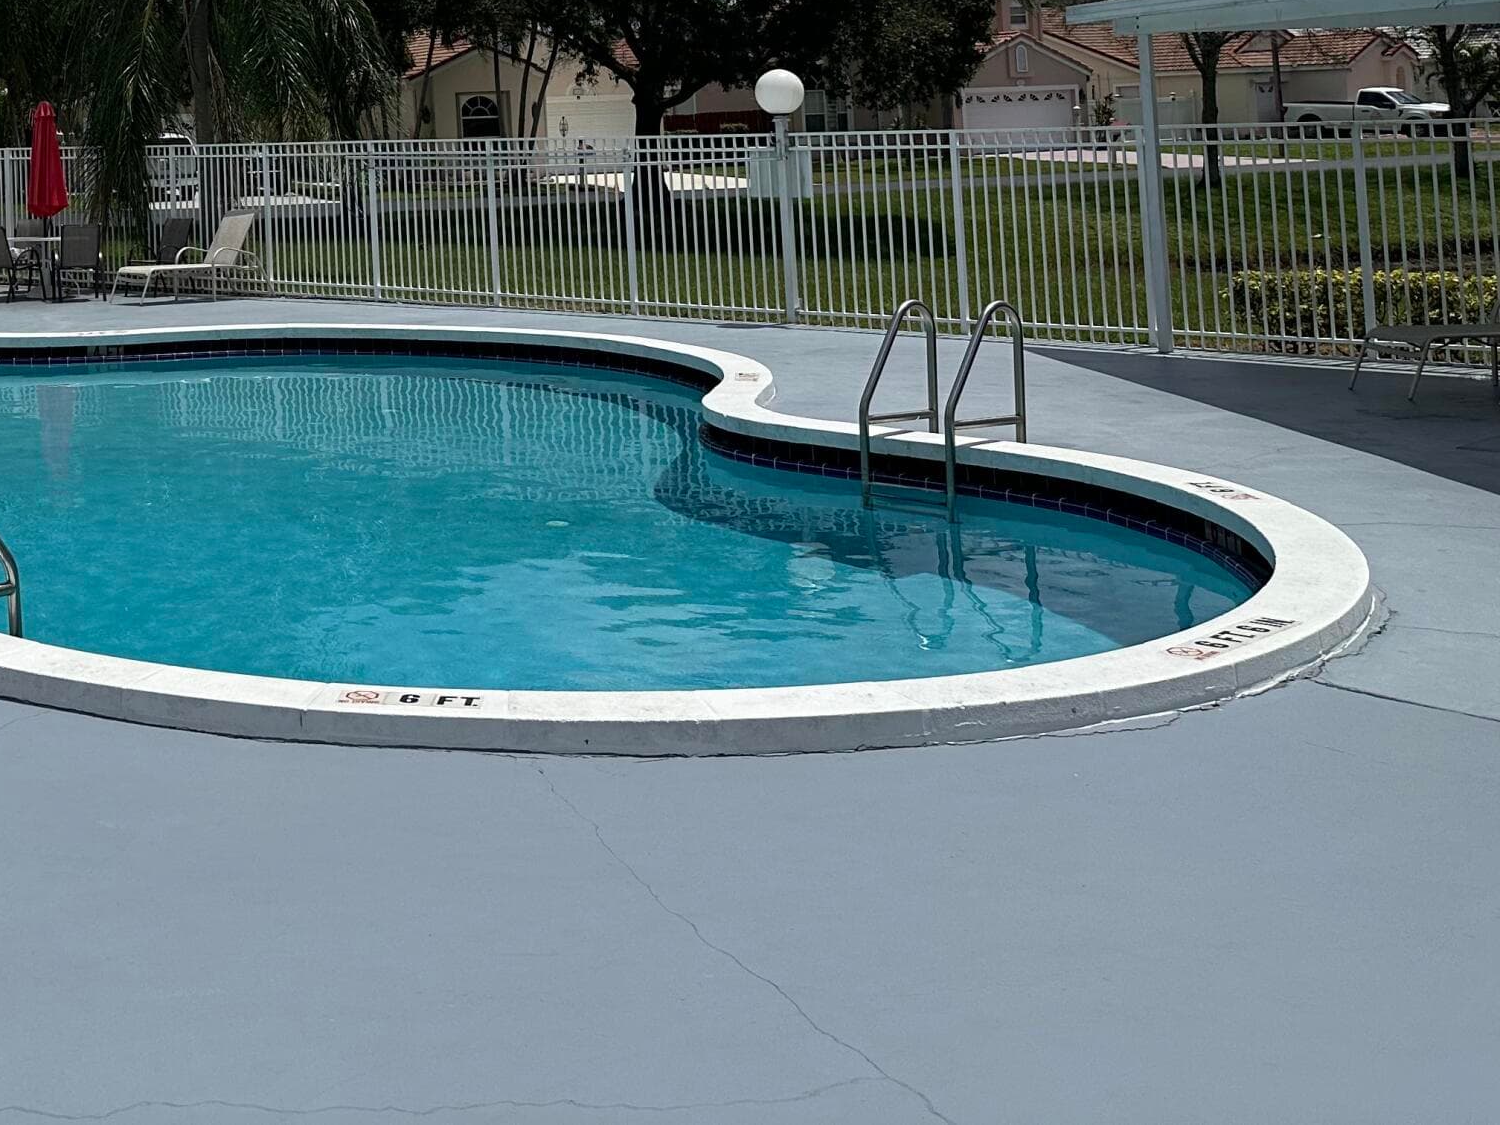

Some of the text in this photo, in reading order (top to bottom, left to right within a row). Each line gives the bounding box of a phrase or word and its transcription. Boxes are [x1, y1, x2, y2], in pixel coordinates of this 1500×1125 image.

[1194, 640, 1229, 648] 6
[1236, 625, 1271, 633] 6
[399, 693, 481, 707] 6 FT.
